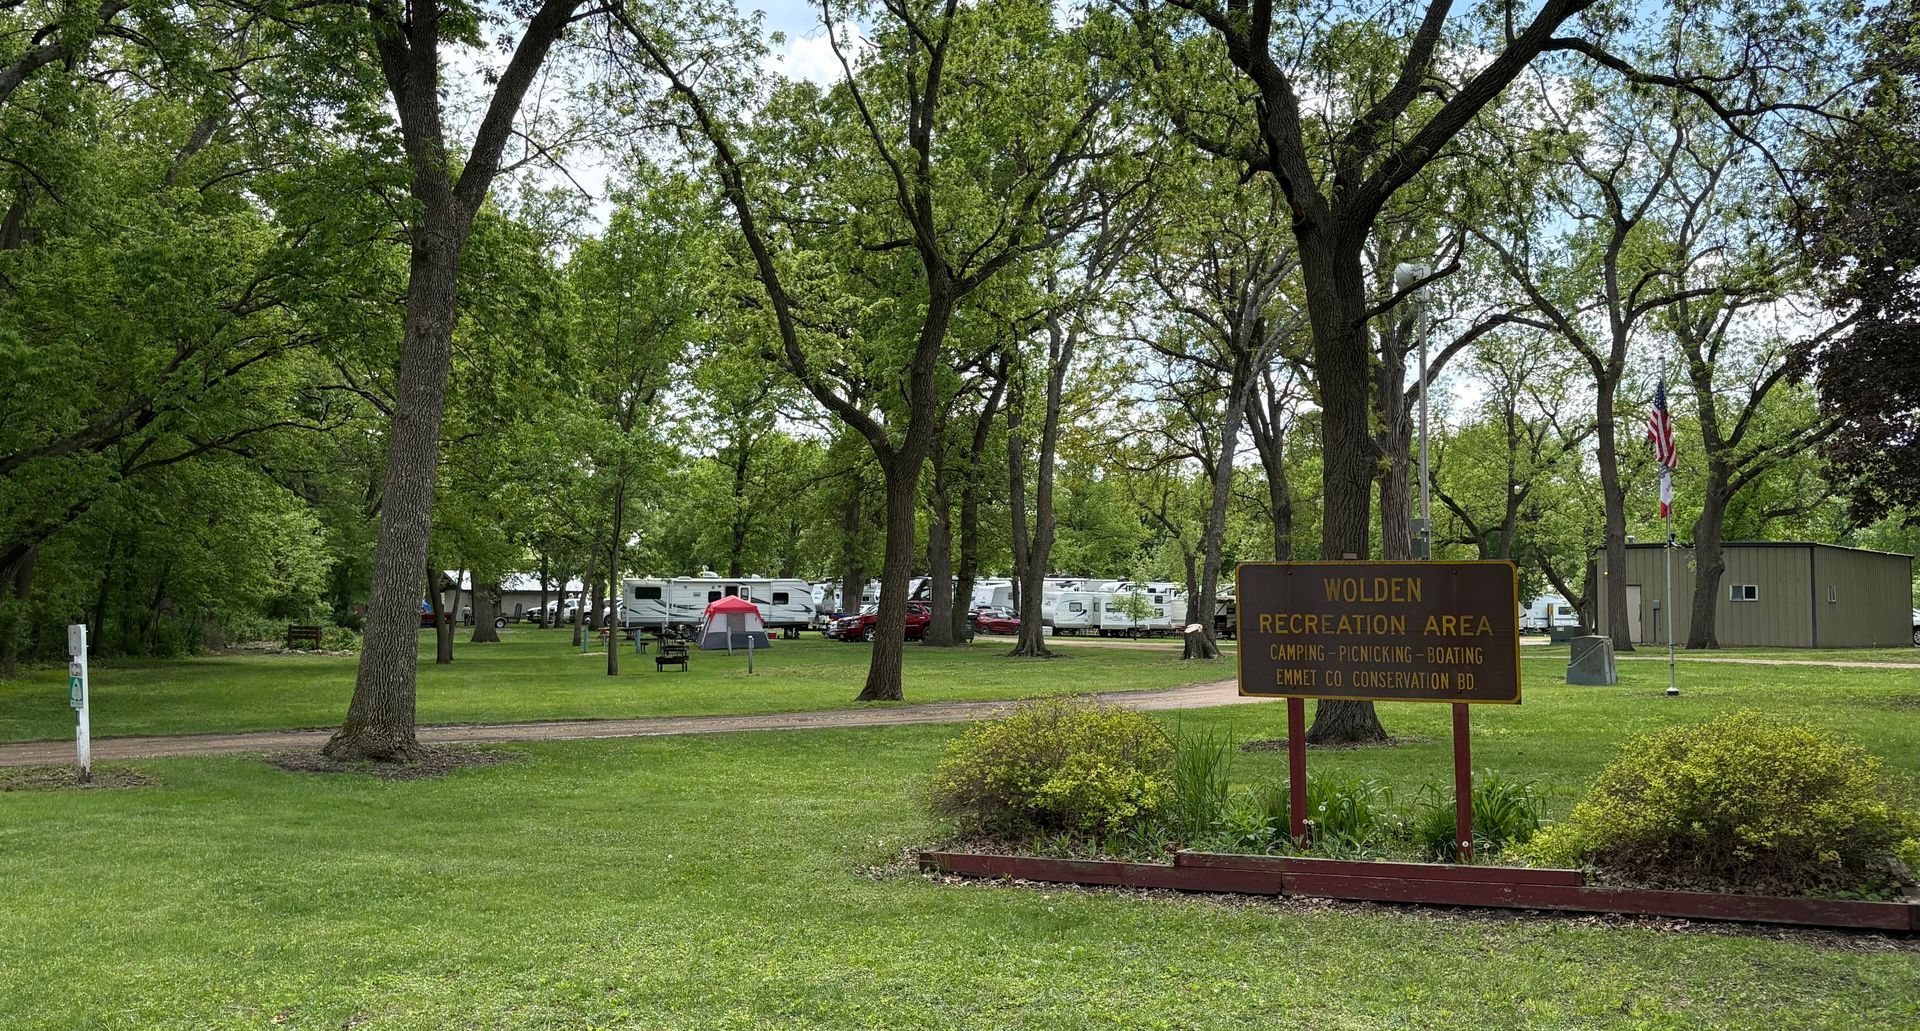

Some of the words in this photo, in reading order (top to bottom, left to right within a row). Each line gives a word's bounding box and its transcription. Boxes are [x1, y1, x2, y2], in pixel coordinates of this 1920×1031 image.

[1323, 577, 1422, 603] WOLDEN
[1259, 613, 1406, 636] RECREATION
[1423, 615, 1494, 637] AREA
[1270, 643, 1325, 662] CAMPING
[1339, 645, 1412, 664] PICNICKING
[1427, 646, 1483, 665] BOATING
[1276, 668, 1317, 687] EMMET
[1352, 670, 1449, 690] CONSERVATION
